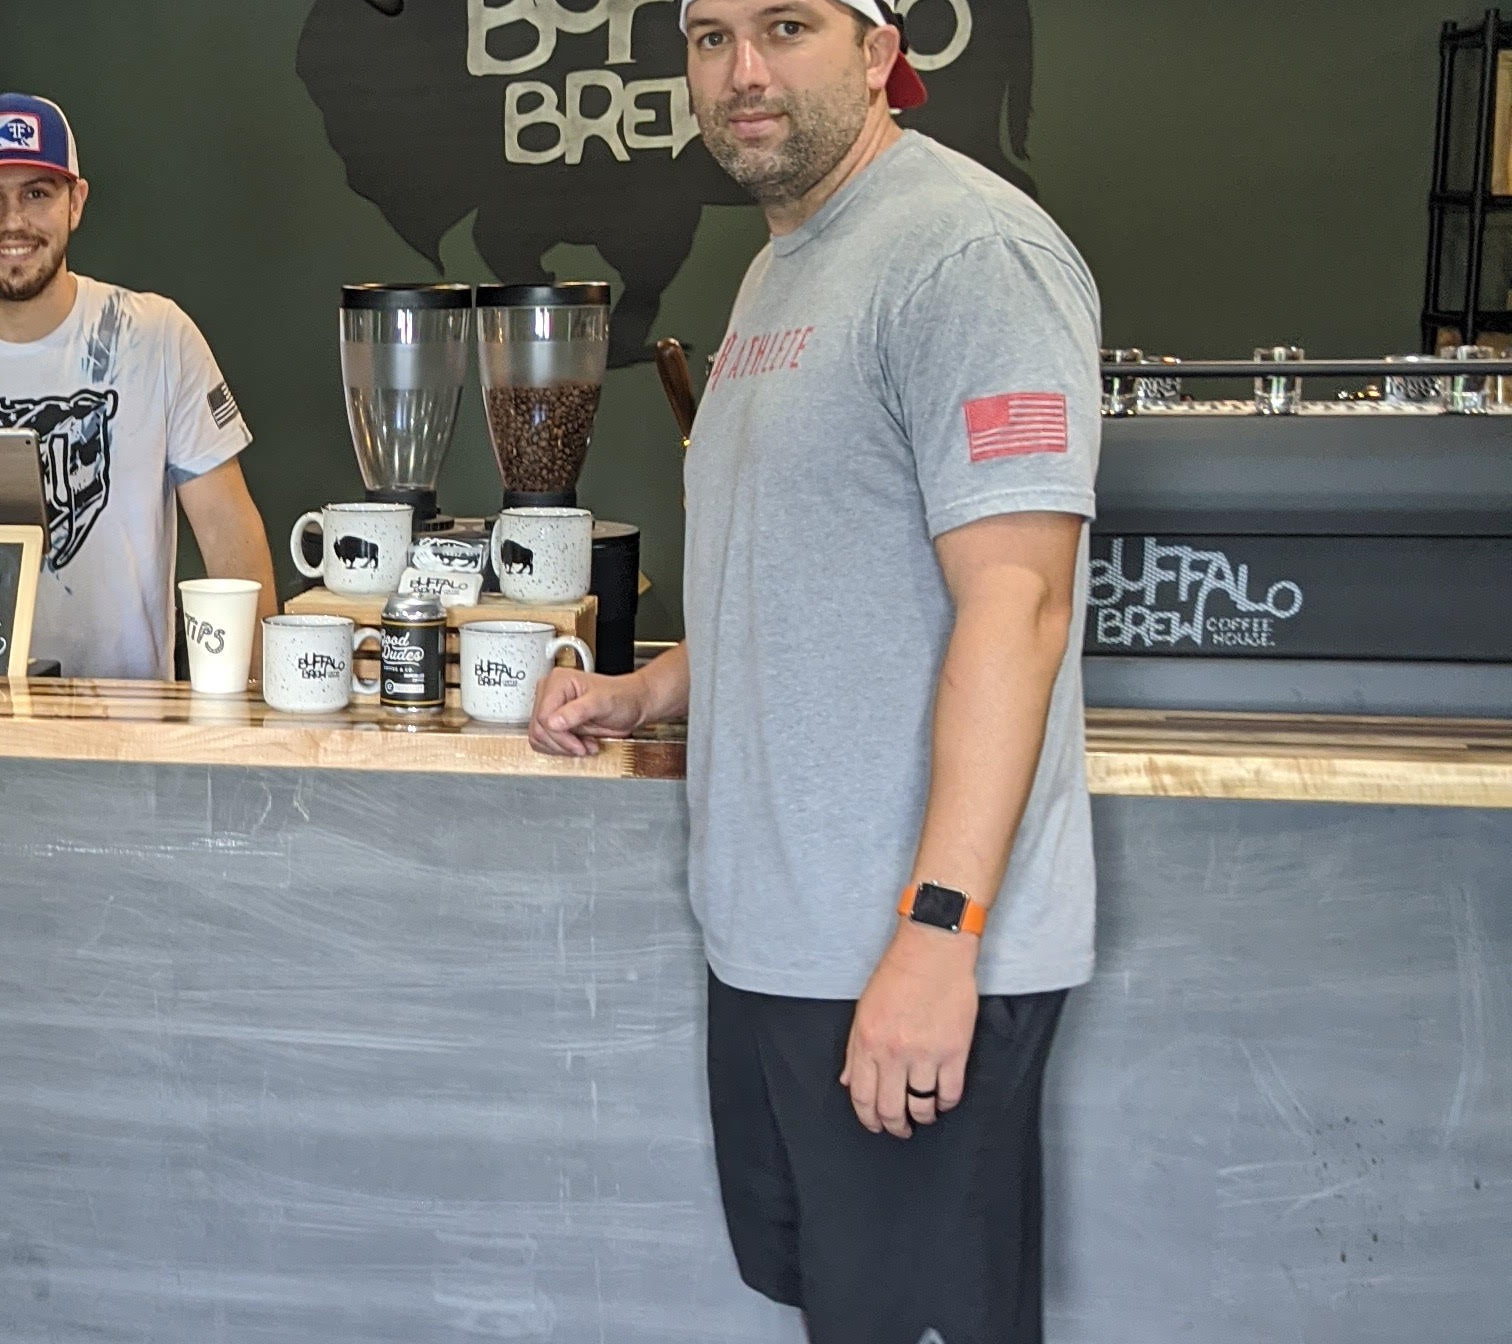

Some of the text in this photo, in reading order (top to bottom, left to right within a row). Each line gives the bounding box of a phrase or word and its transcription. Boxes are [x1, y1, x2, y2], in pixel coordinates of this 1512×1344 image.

[1087, 536, 1303, 619] BUFFALO
[1096, 605, 1204, 647] BREW
[474, 659, 525, 680] BUFFALO
